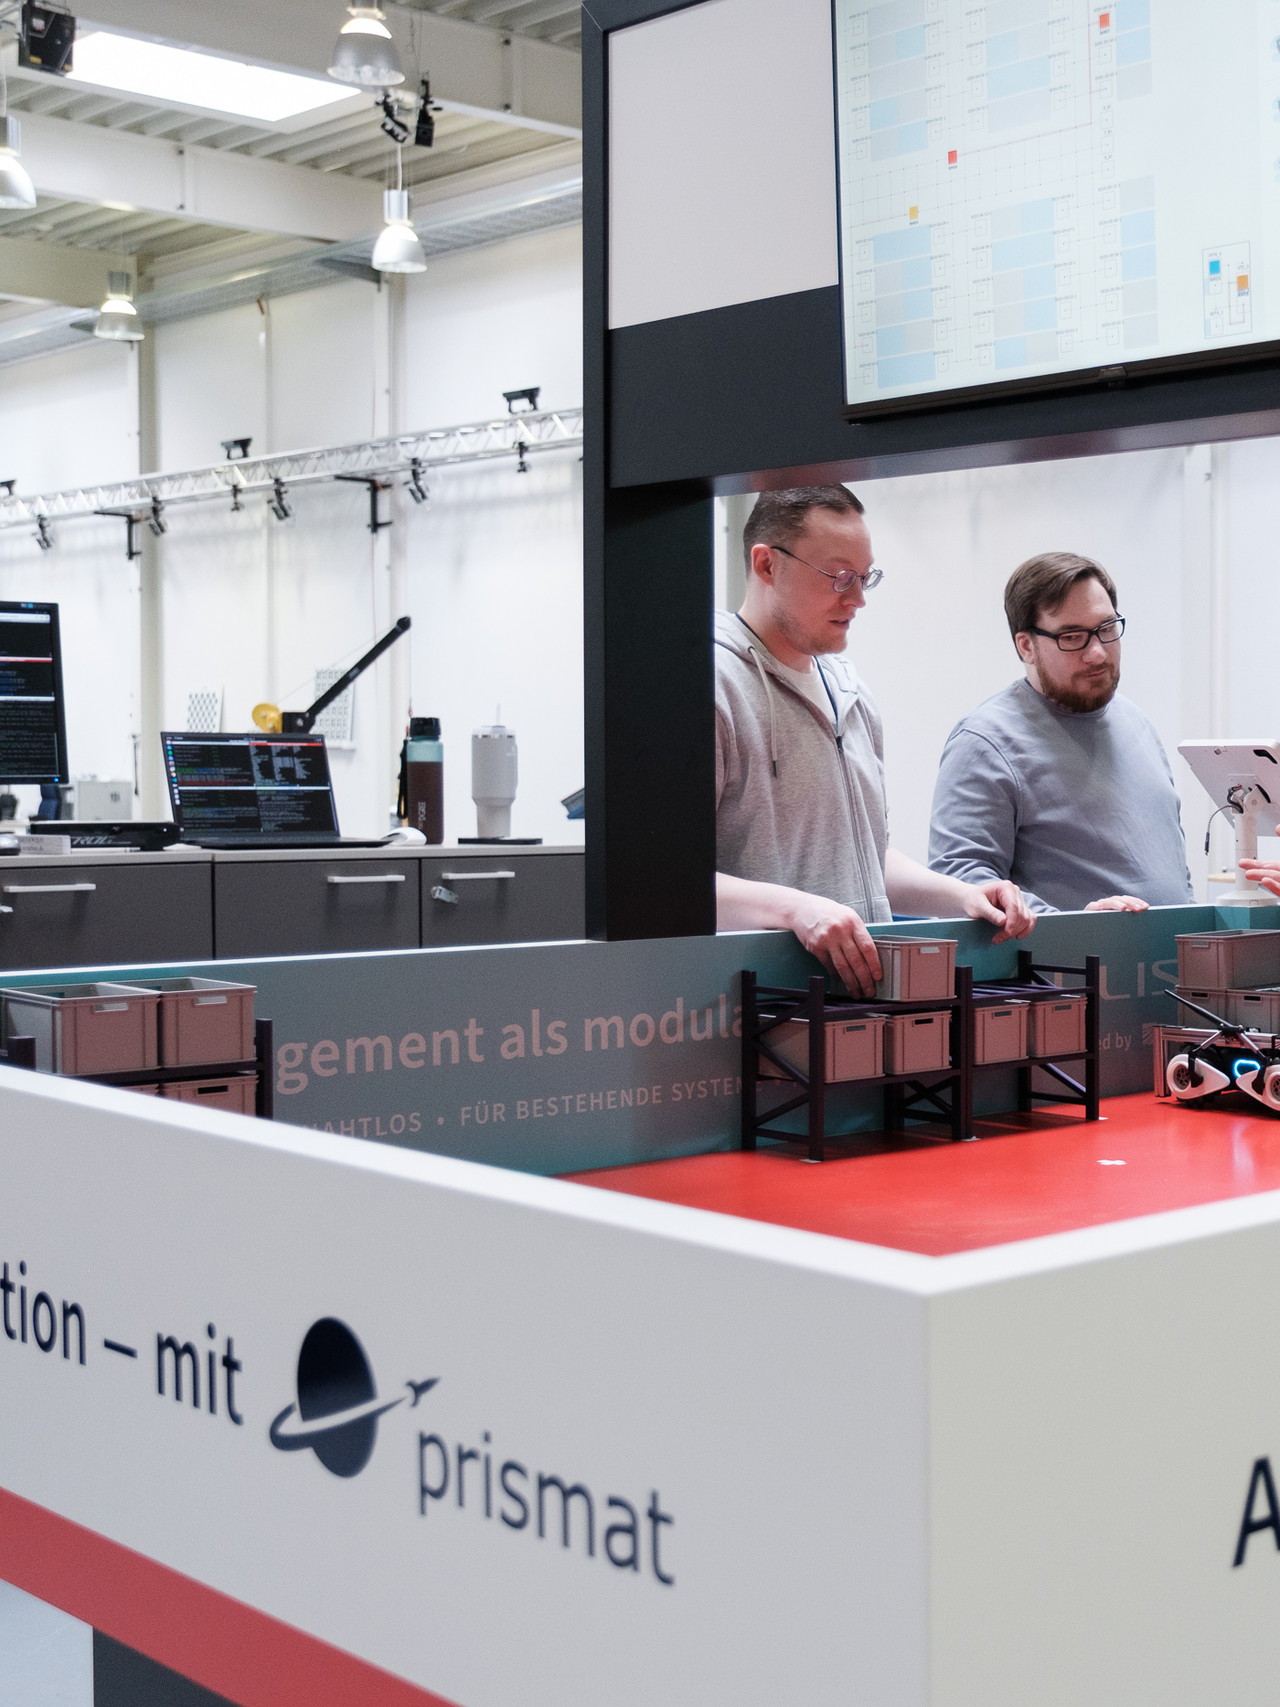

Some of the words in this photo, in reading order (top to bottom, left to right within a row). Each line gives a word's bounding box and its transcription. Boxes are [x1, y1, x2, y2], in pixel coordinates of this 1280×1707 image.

[276, 1017, 485, 1095] gement
[500, 1008, 568, 1058] als
[1115, 1032, 1132, 1051] by
[305, 1111, 422, 1139] AHTLOS
[461, 1100, 506, 1127] FÜR
[516, 1085, 662, 1120] BESTEHENDE
[156, 1322, 245, 1427] mit
[418, 1430, 676, 1588] prismat
